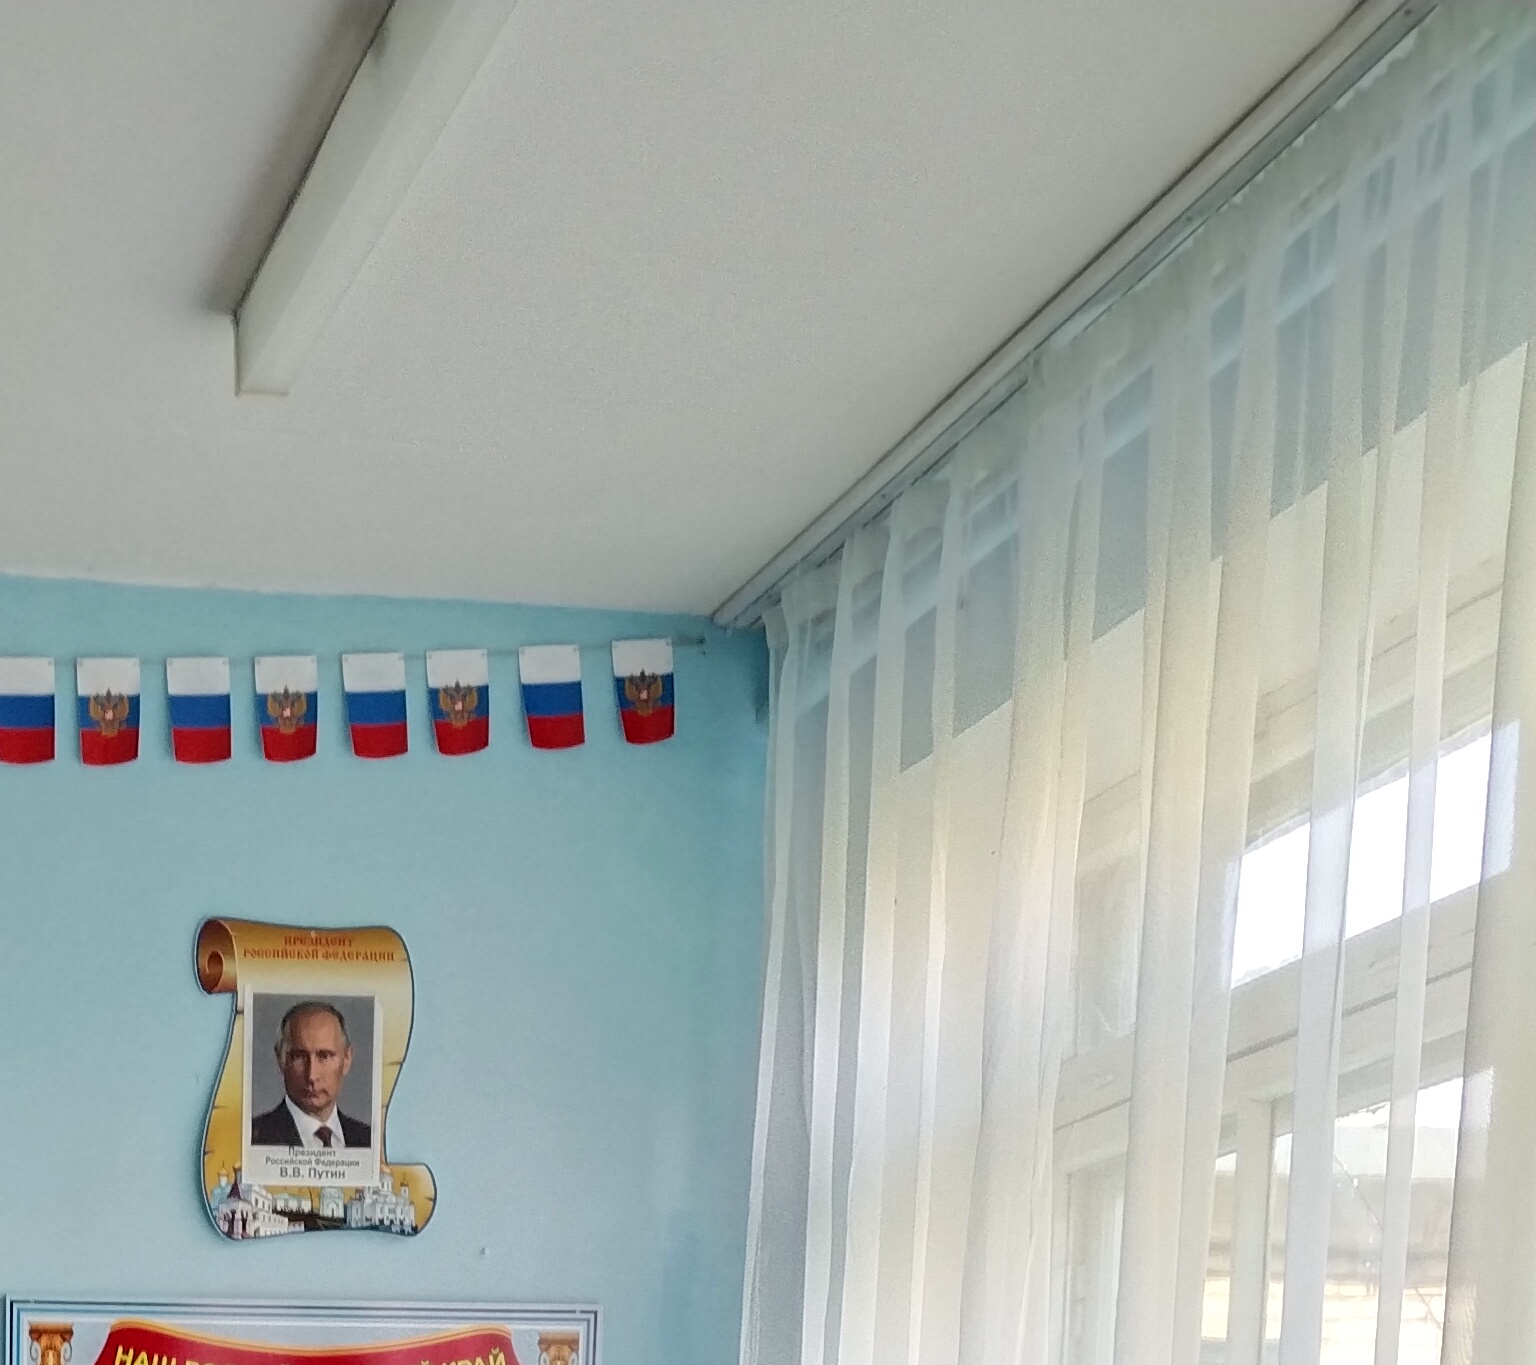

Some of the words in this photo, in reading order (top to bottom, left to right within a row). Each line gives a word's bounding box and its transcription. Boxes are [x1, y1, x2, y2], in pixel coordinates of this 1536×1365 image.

[283, 934, 353, 949] ПРЕЗИДЕНТ
[243, 947, 318, 960] РОССИЙСКОЙ
[321, 950, 395, 963] ФЕДЕРАЦИИ
[288, 1145, 337, 1158] Президент
[265, 1156, 312, 1168] Российской
[314, 1157, 360, 1169] Федерации
[280, 1166, 305, 1178] В.В.
[307, 1167, 346, 1180] Путин
